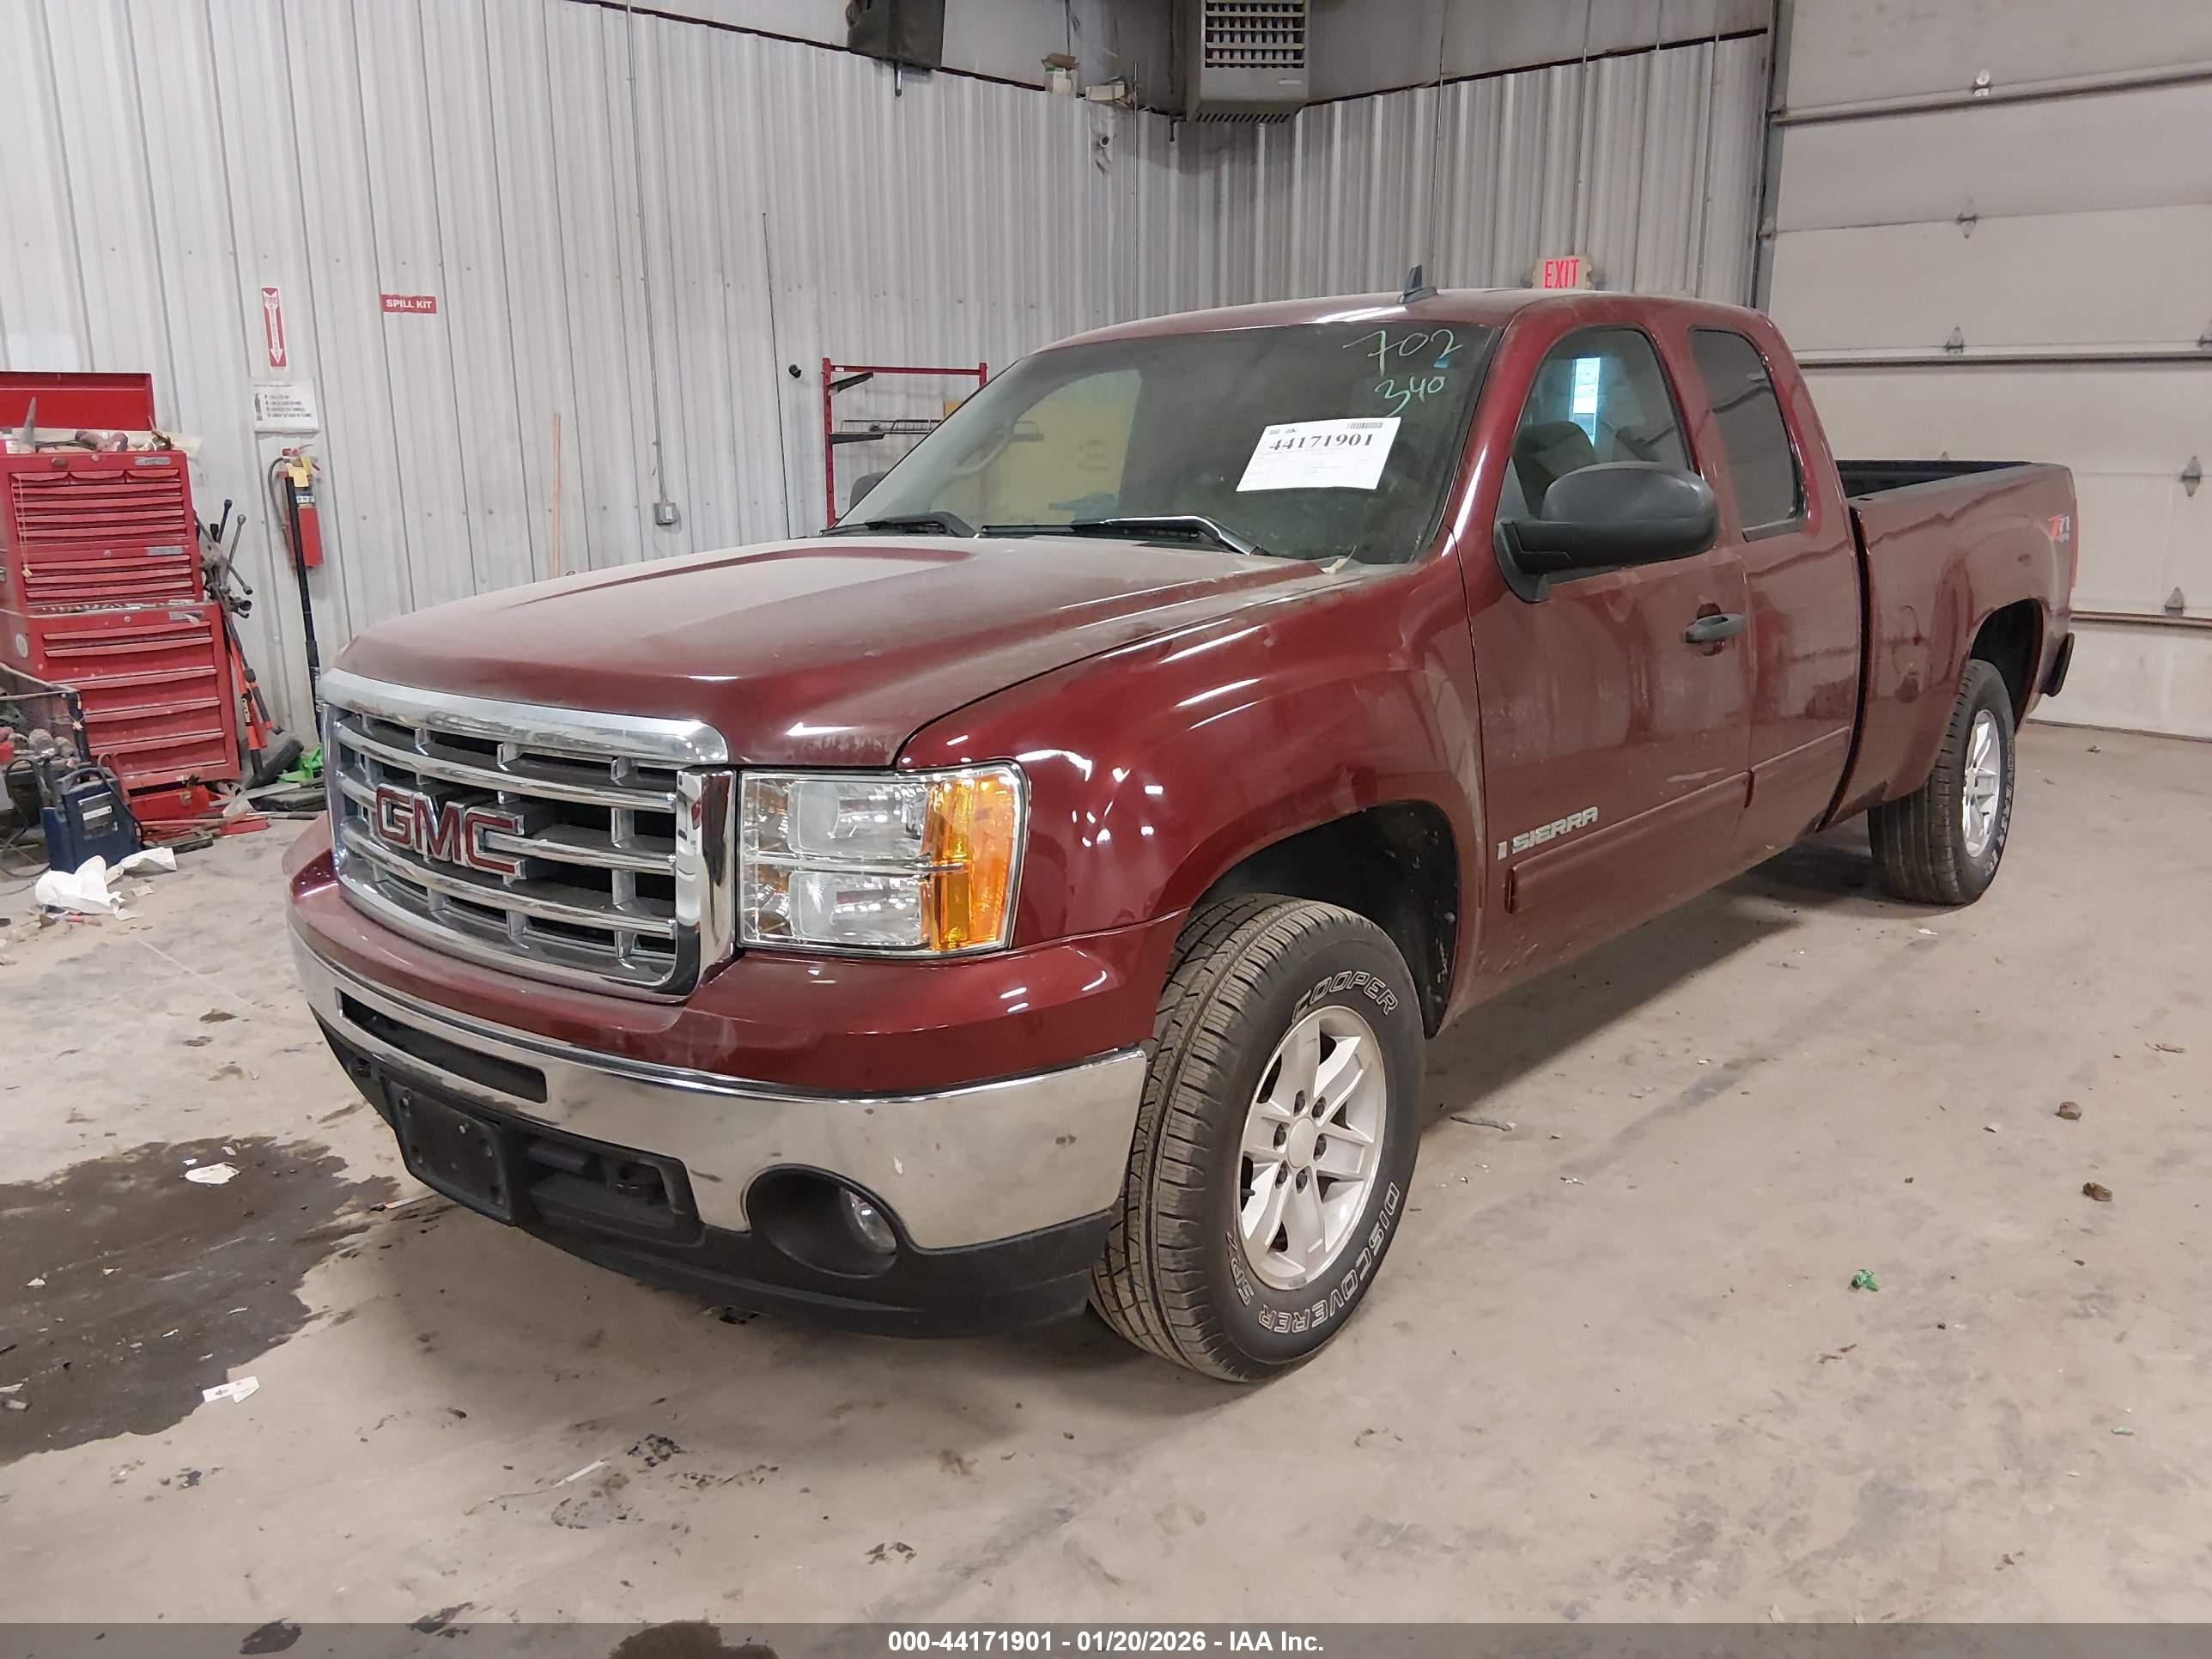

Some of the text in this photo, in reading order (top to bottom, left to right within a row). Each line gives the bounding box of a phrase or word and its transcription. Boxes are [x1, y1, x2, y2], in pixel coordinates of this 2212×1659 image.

[1543, 259, 1580, 289] EXIT
[386, 299, 433, 309] SPILL KIT
[1342, 329, 1462, 376] 702
[1375, 376, 1445, 417] 340
[1269, 433, 1374, 451] 44171901
[376, 783, 526, 878] GMC
[1512, 806, 1599, 854] SIERRA
[1291, 970, 1398, 1023] COOPER
[1259, 1182, 1401, 1334] DISCOVERER
